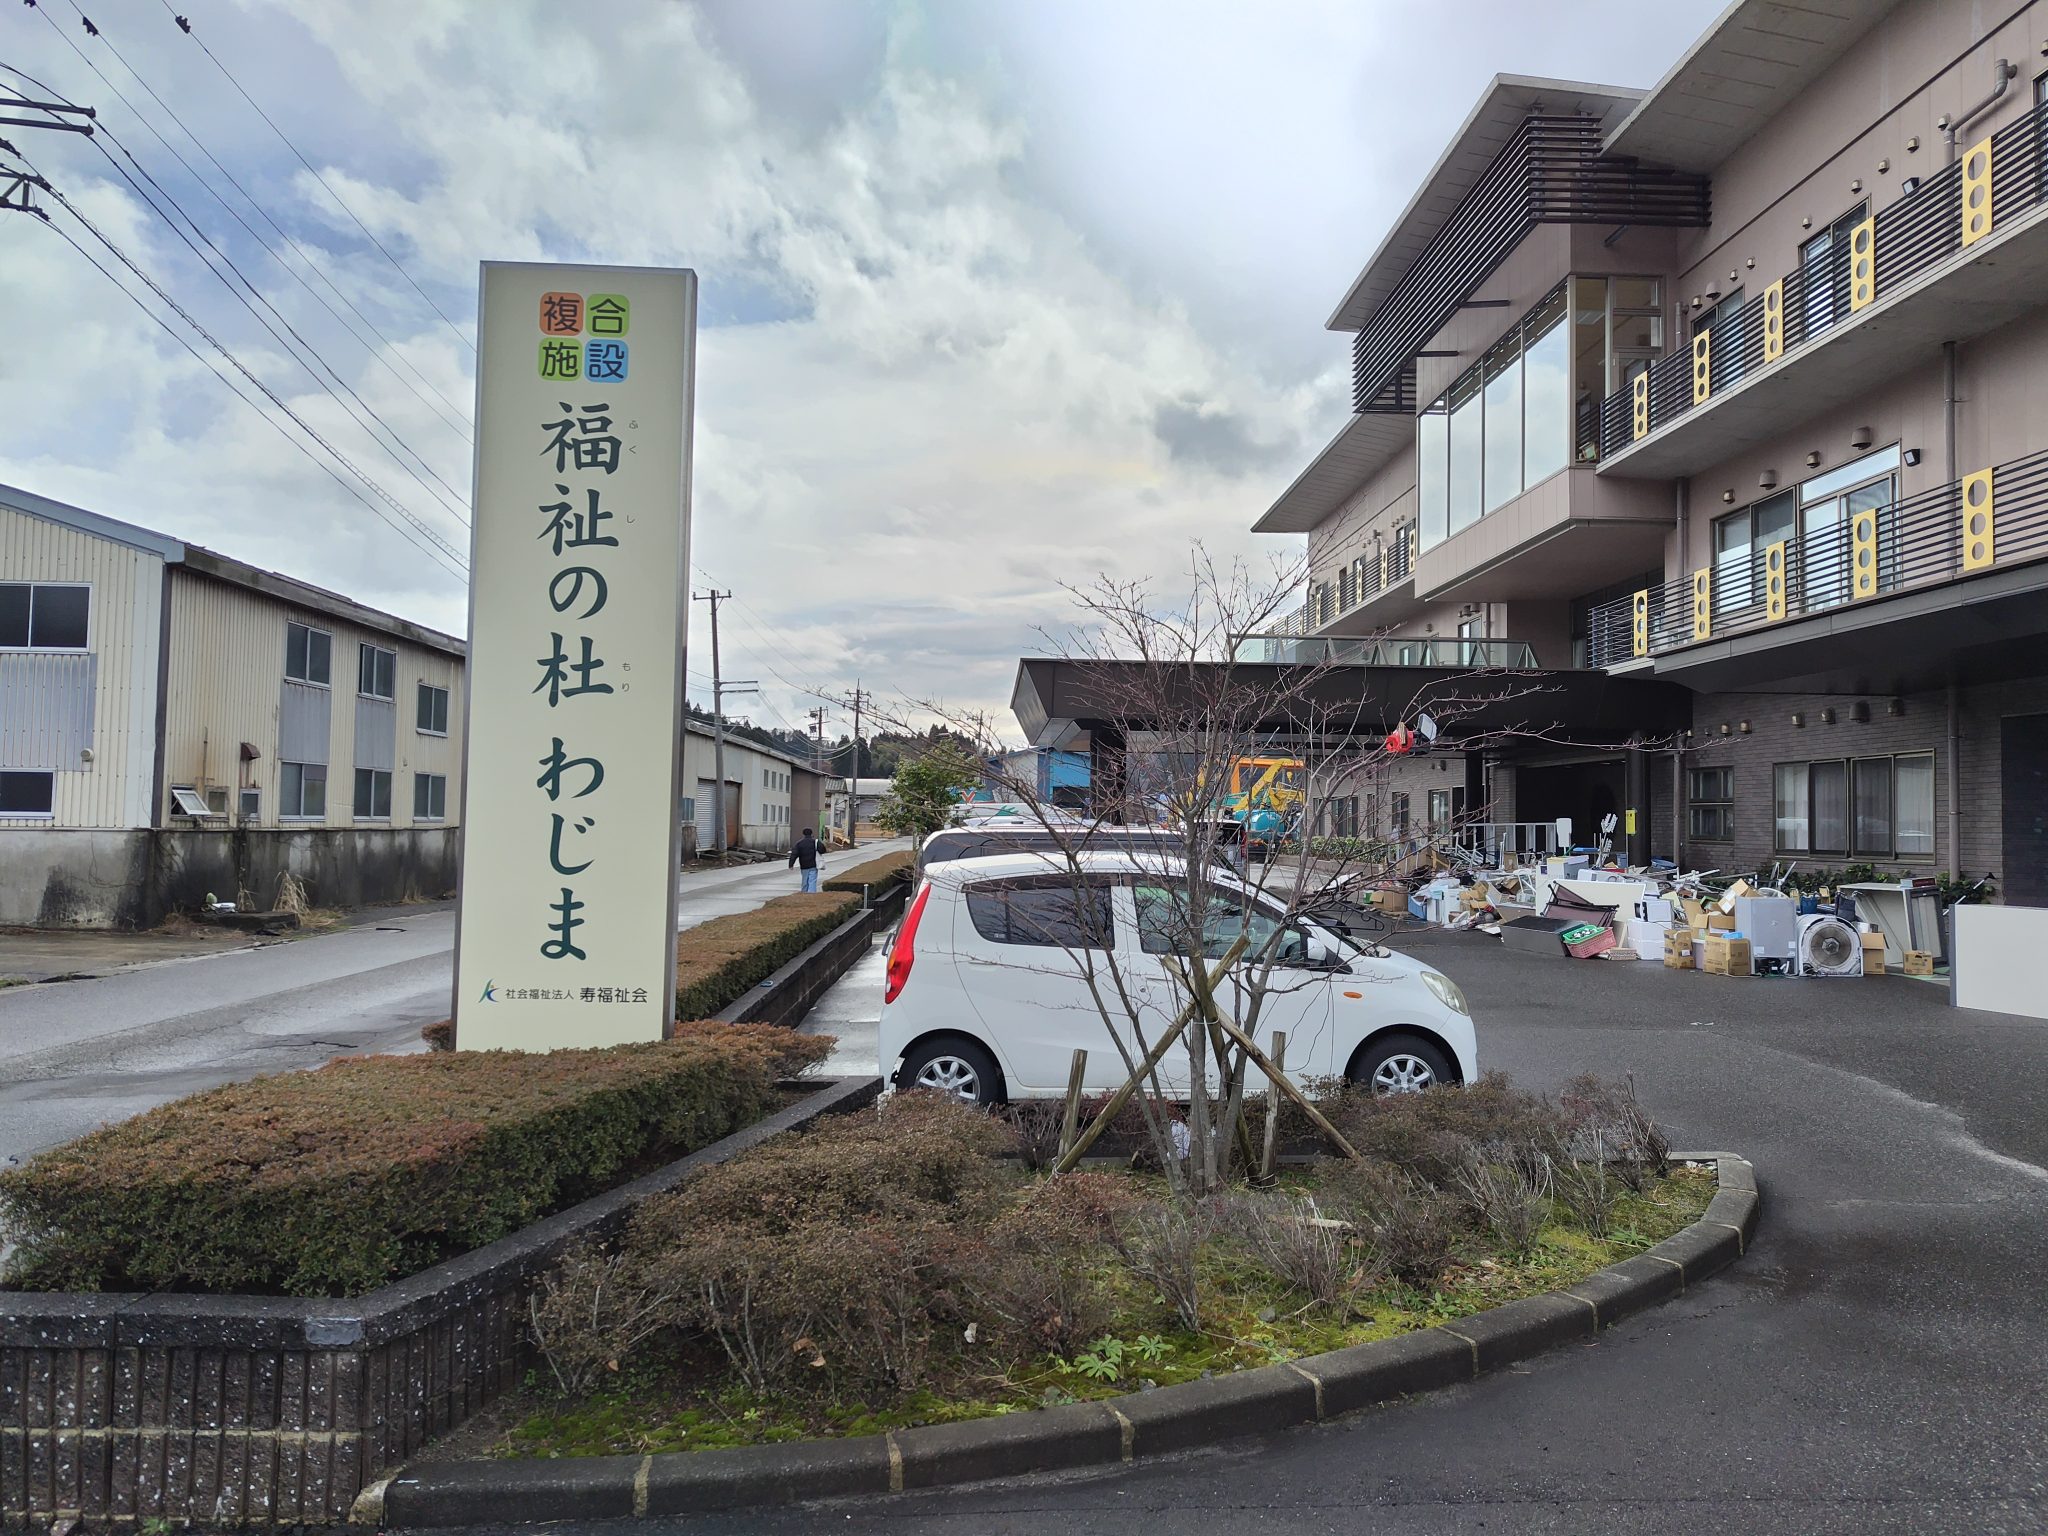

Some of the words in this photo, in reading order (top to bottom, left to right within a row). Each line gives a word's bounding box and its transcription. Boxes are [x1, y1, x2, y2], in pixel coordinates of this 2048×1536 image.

[542, 297, 627, 334] 複合
[541, 341, 625, 379] 施設
[532, 401, 622, 707] 福祉の杜
[621, 662, 631, 692] もり
[536, 737, 604, 960] わじま
[505, 988, 574, 1000] 社会福祉法人
[579, 986, 648, 1003] 寿福祉会
